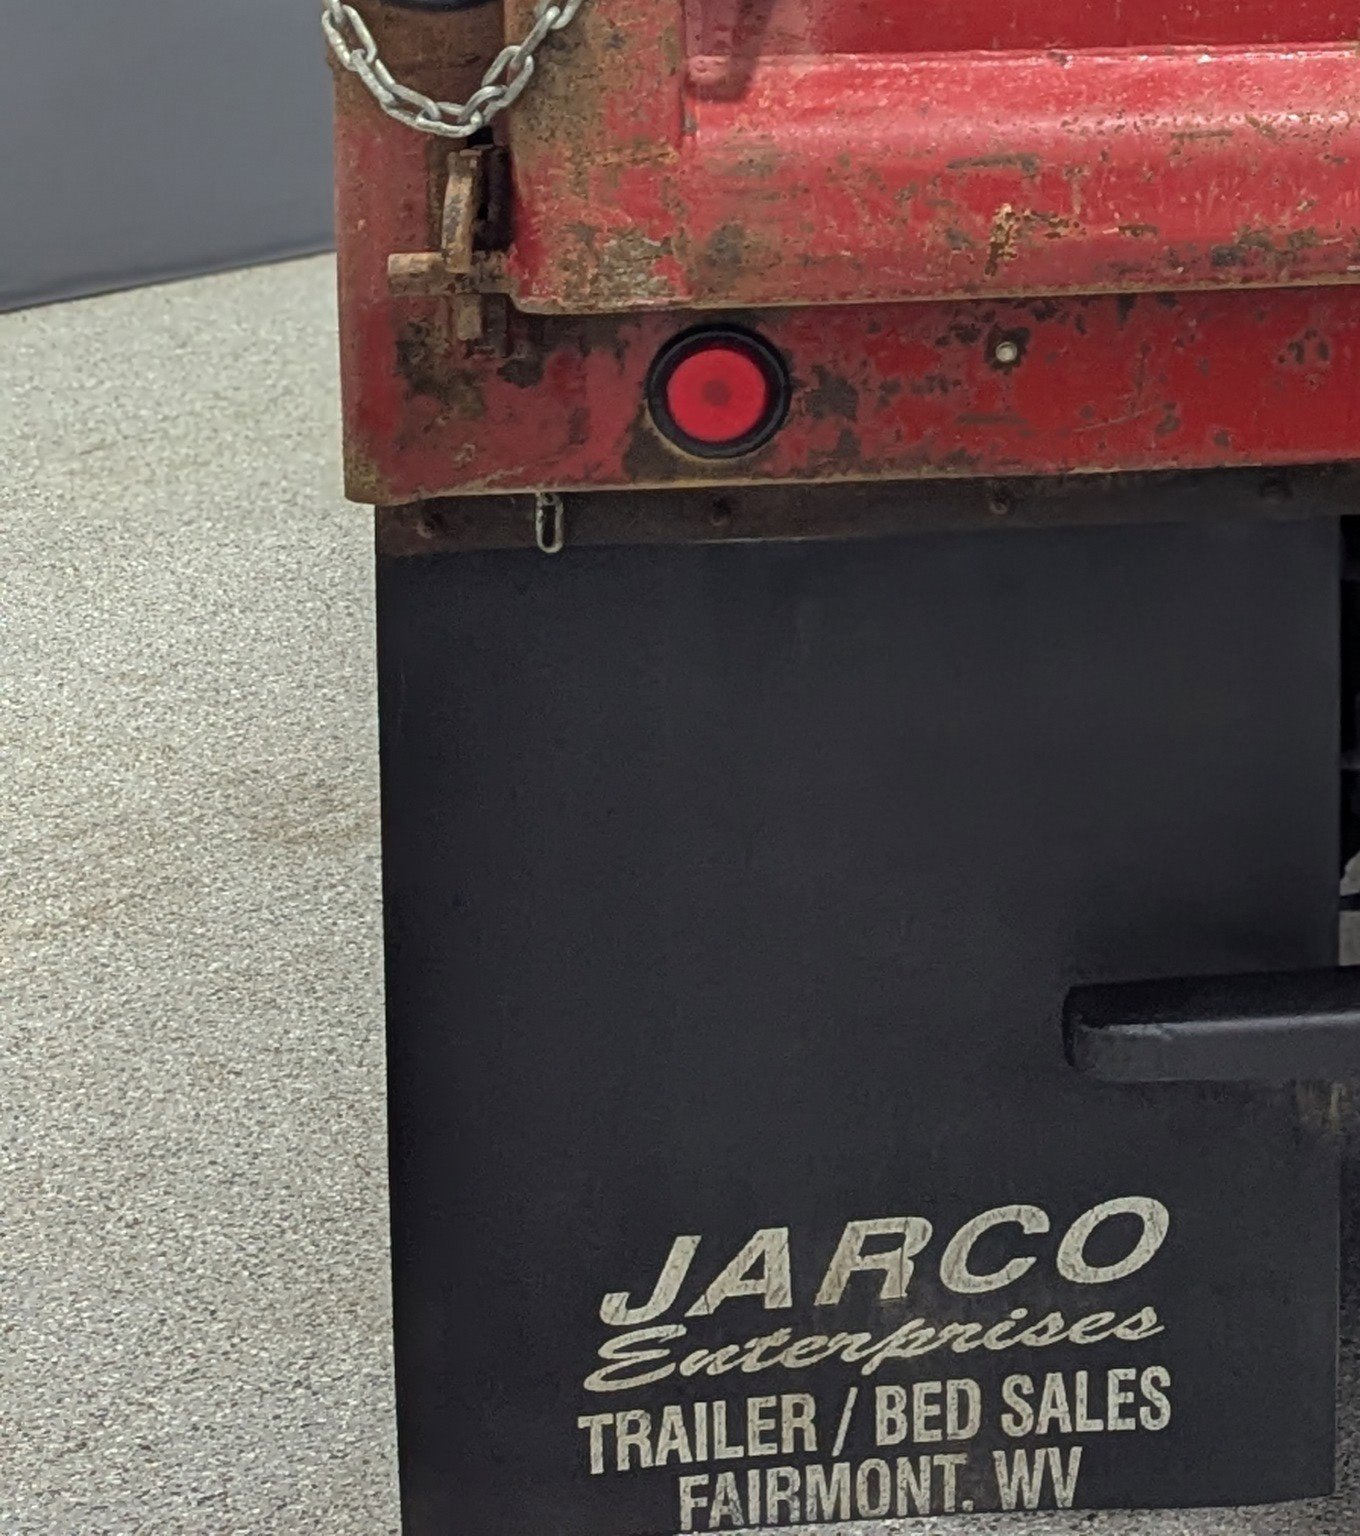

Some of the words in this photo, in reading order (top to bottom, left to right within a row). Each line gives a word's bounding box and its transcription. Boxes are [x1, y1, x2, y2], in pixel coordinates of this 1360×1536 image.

[599, 1195, 1170, 1326] JARCO
[583, 1306, 1165, 1393] Enterprises
[577, 1393, 818, 1475] TRAILER
[874, 1378, 982, 1447] BED
[1000, 1365, 1171, 1438] SALES
[992, 1445, 1083, 1511] WV
